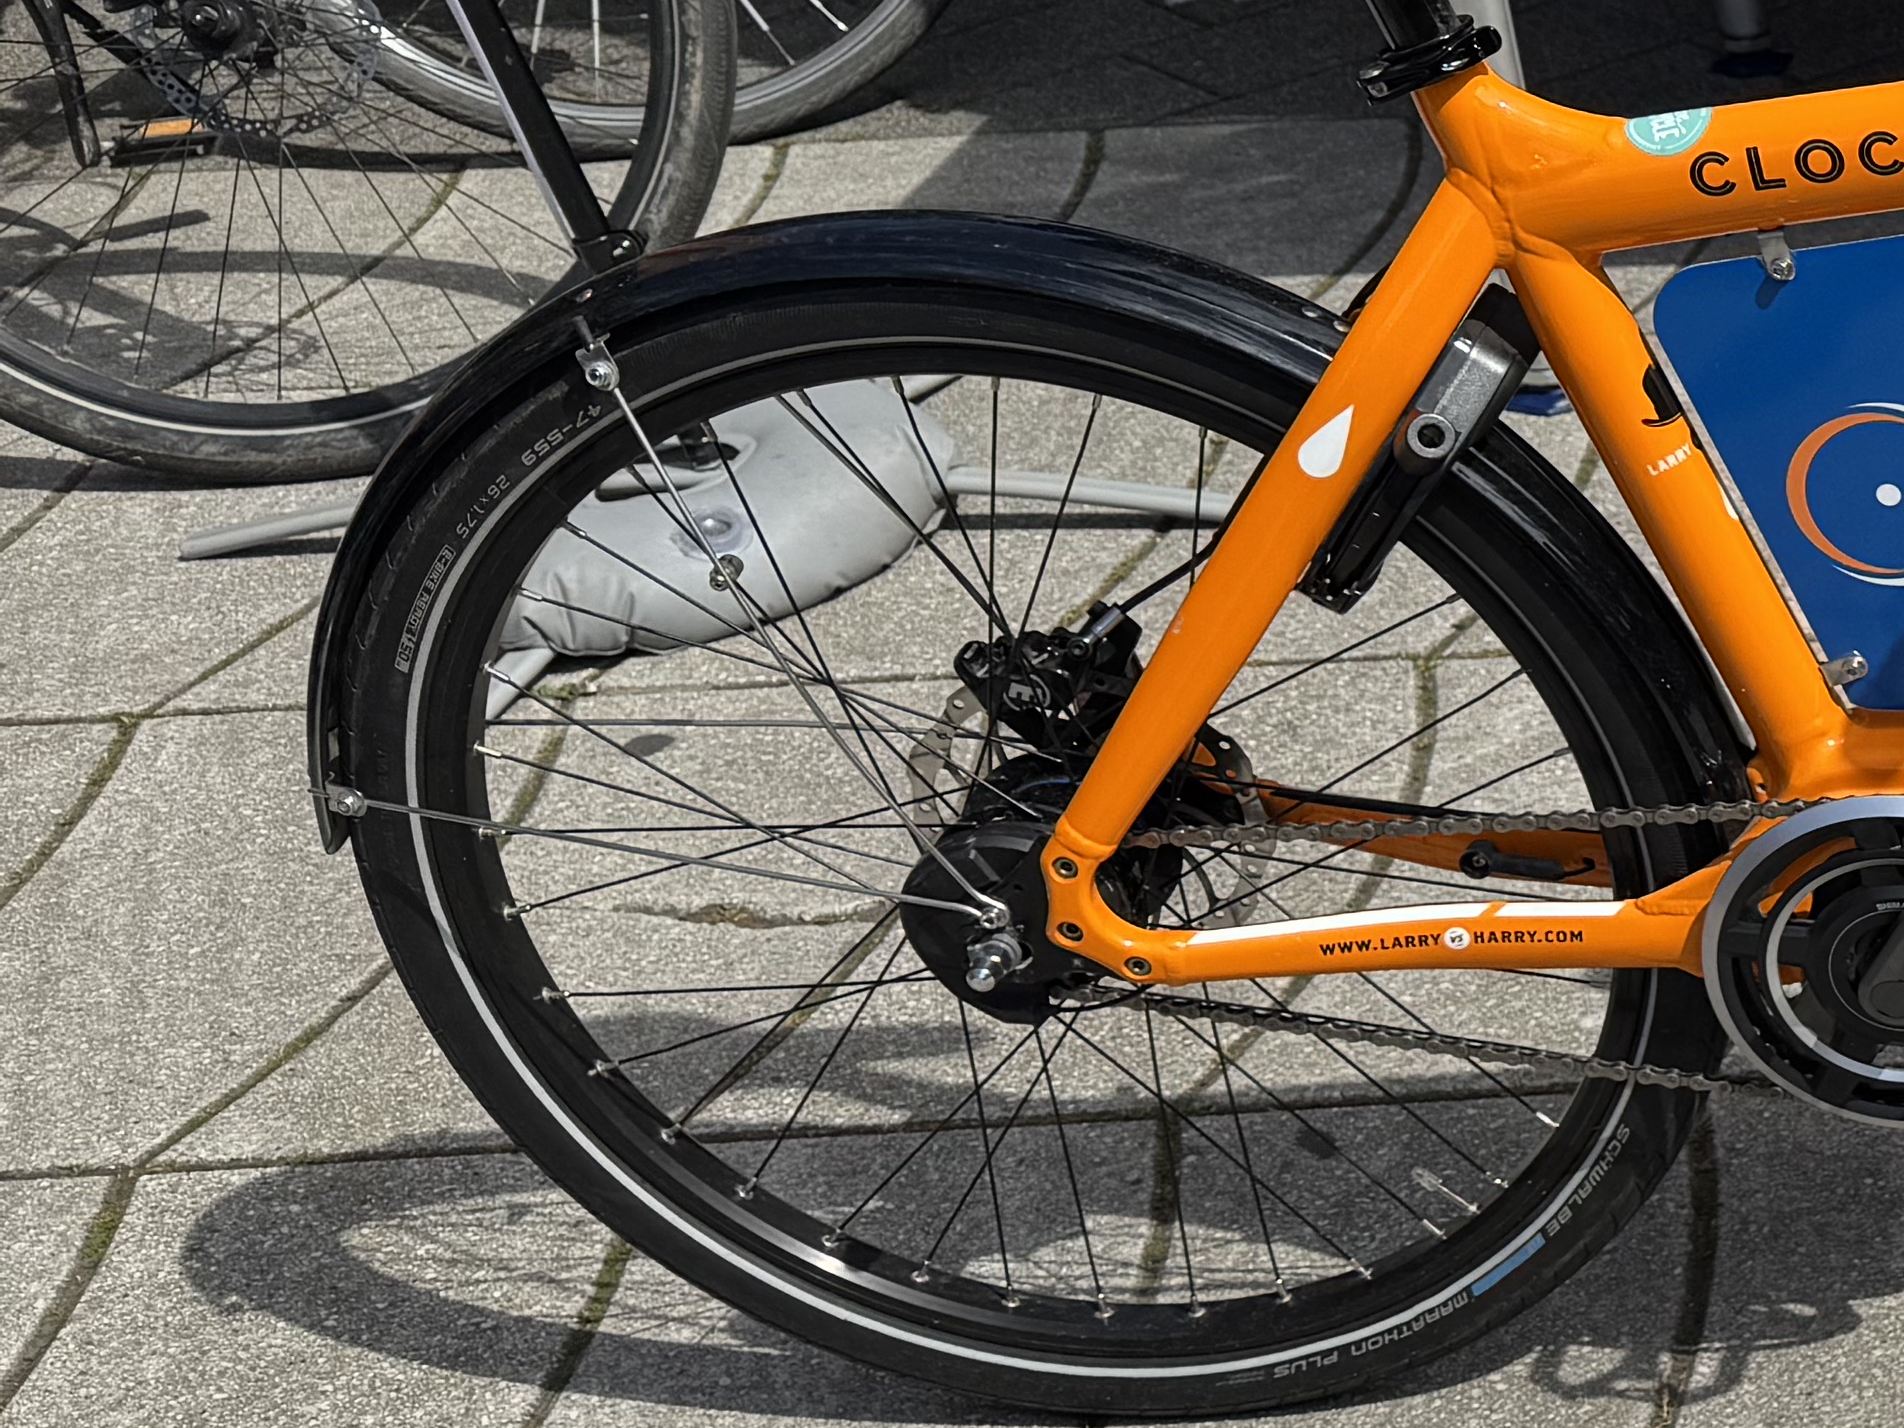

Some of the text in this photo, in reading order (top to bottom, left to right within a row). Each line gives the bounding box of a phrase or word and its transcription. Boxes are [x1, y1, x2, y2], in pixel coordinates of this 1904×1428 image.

[521, 404, 602, 467] 47-559
[1319, 932, 1443, 957] WWW.LARRY
[1473, 930, 1584, 944] HARRY.COM
[1273, 1123, 1631, 1379] SCHWALBE MARATHON PLUS
